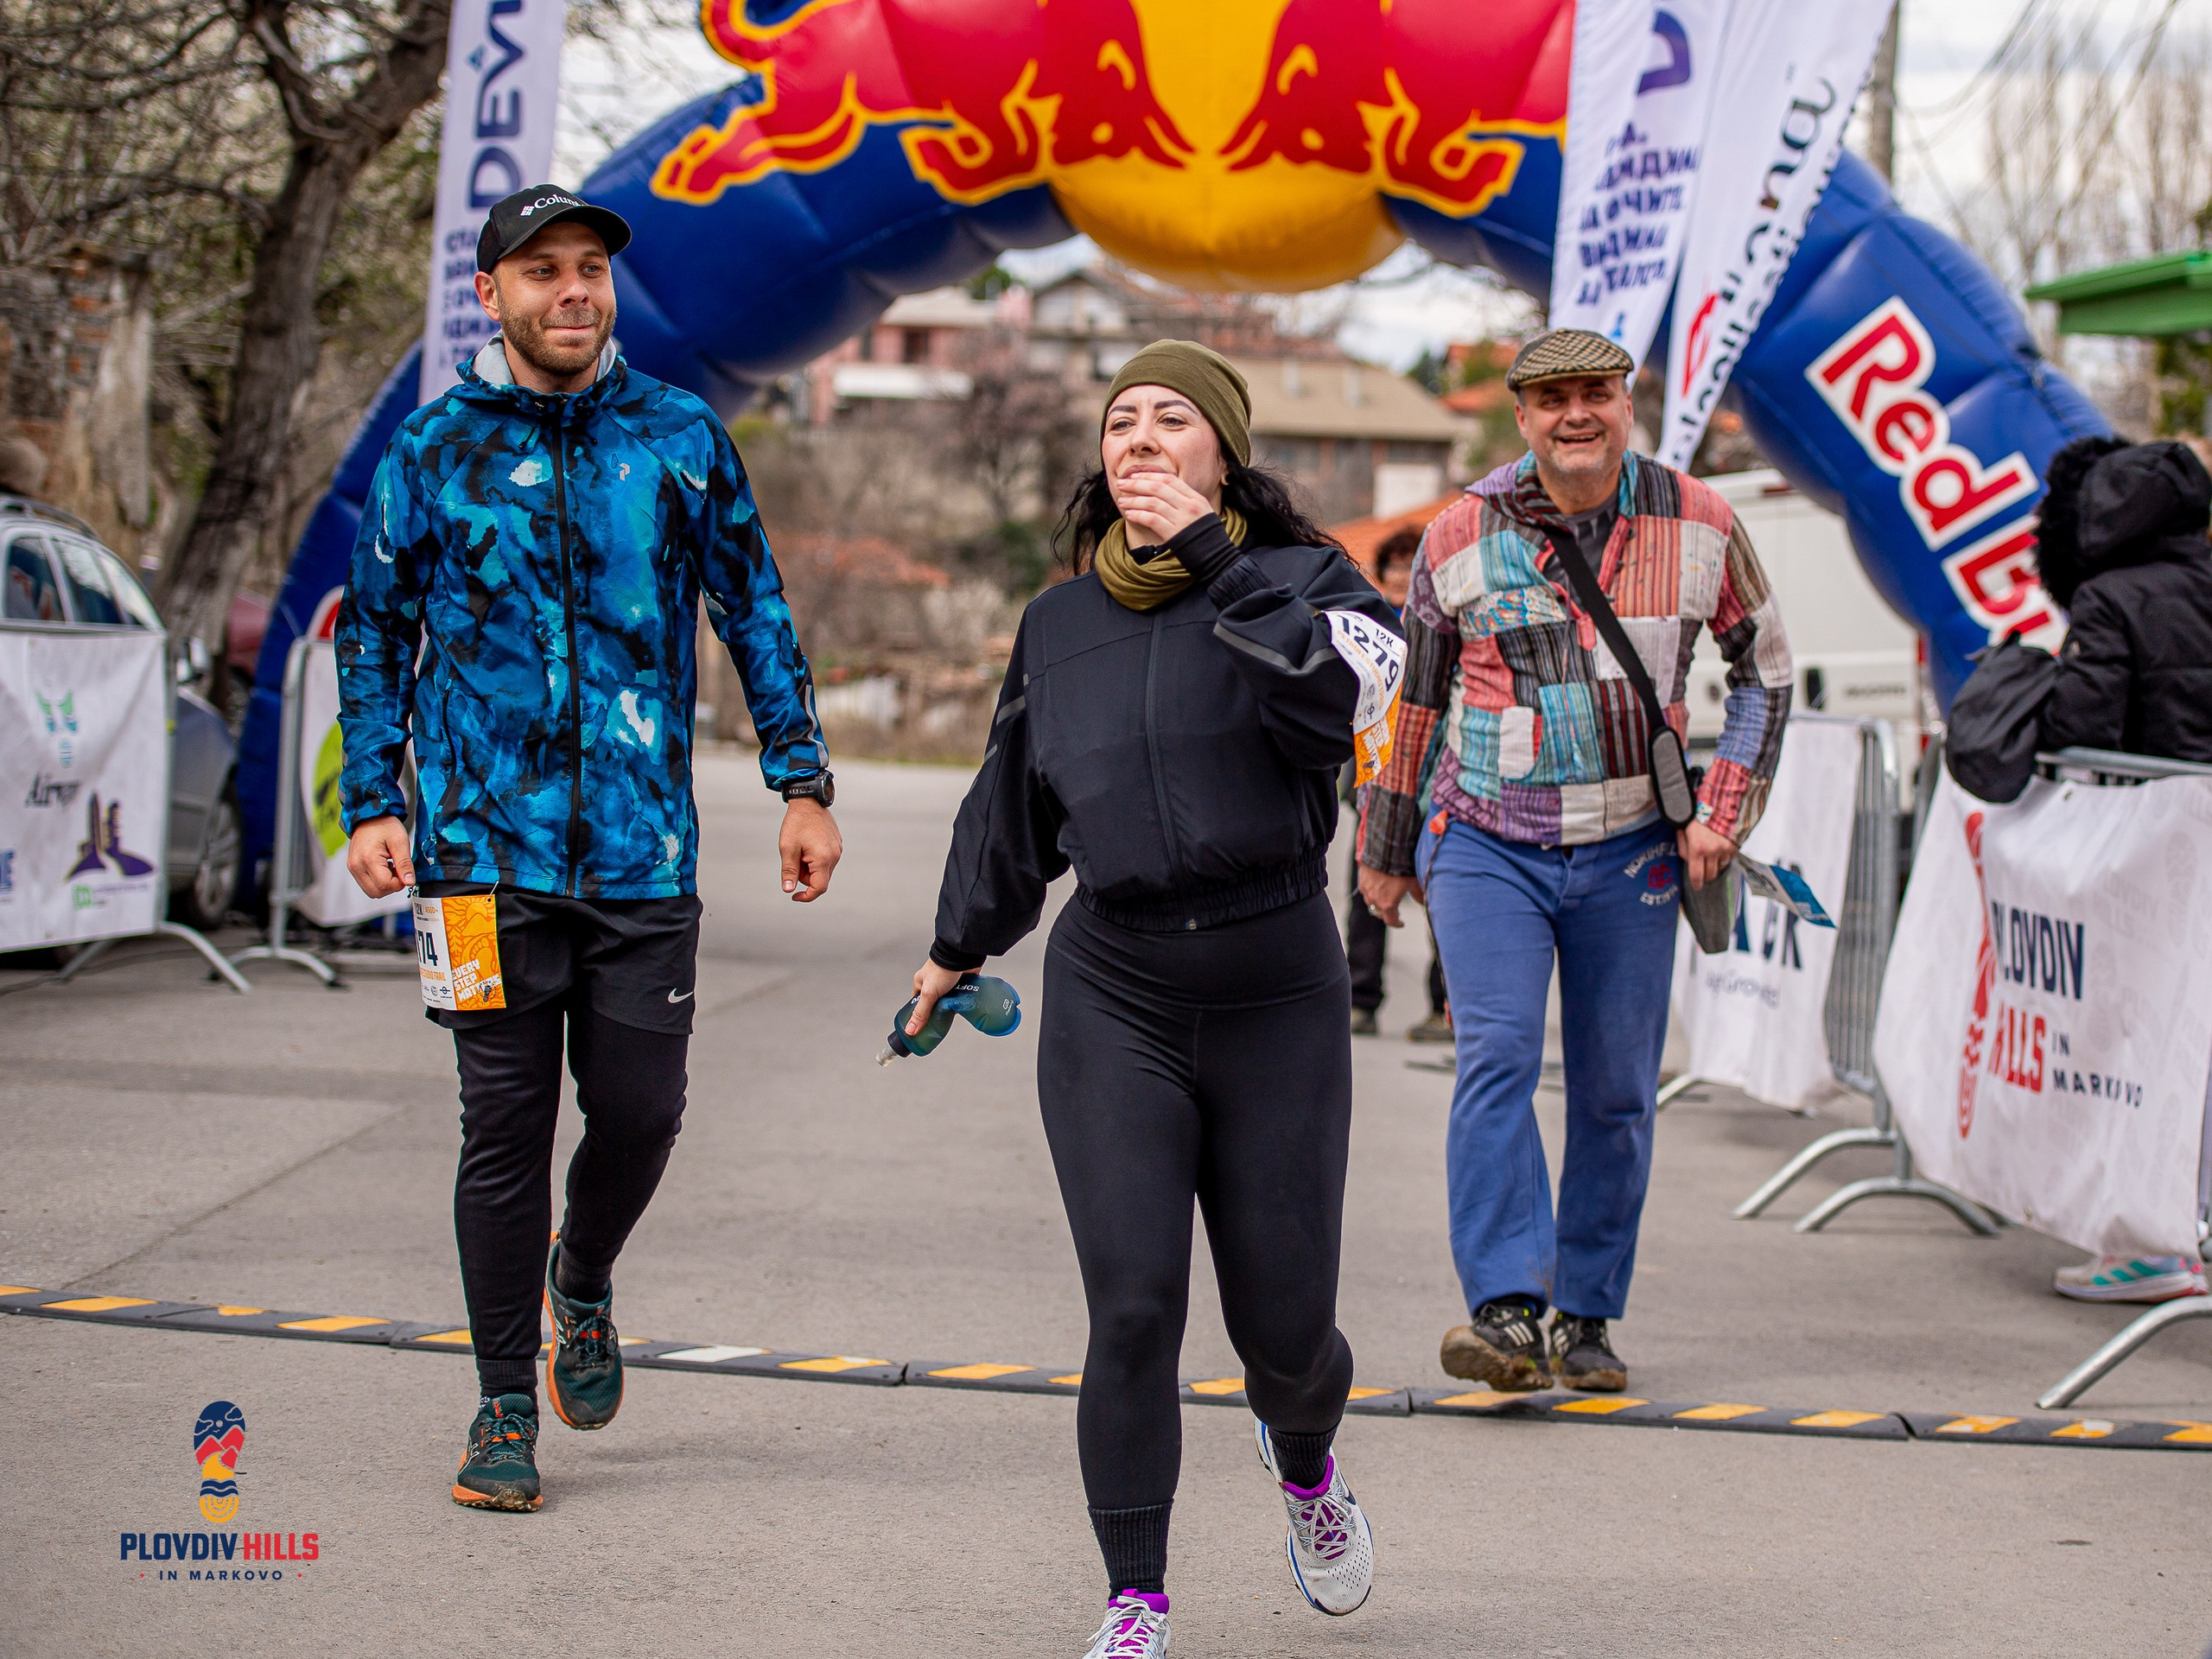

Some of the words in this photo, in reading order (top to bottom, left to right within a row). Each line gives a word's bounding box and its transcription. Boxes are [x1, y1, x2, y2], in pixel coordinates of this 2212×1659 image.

[533, 194, 585, 209] Colum
[1811, 302, 2032, 543] Red
[1375, 627, 1394, 648] 12K
[1338, 614, 1399, 692] 1279
[451, 958, 480, 980] EVERY
[453, 973, 478, 991] STEP
